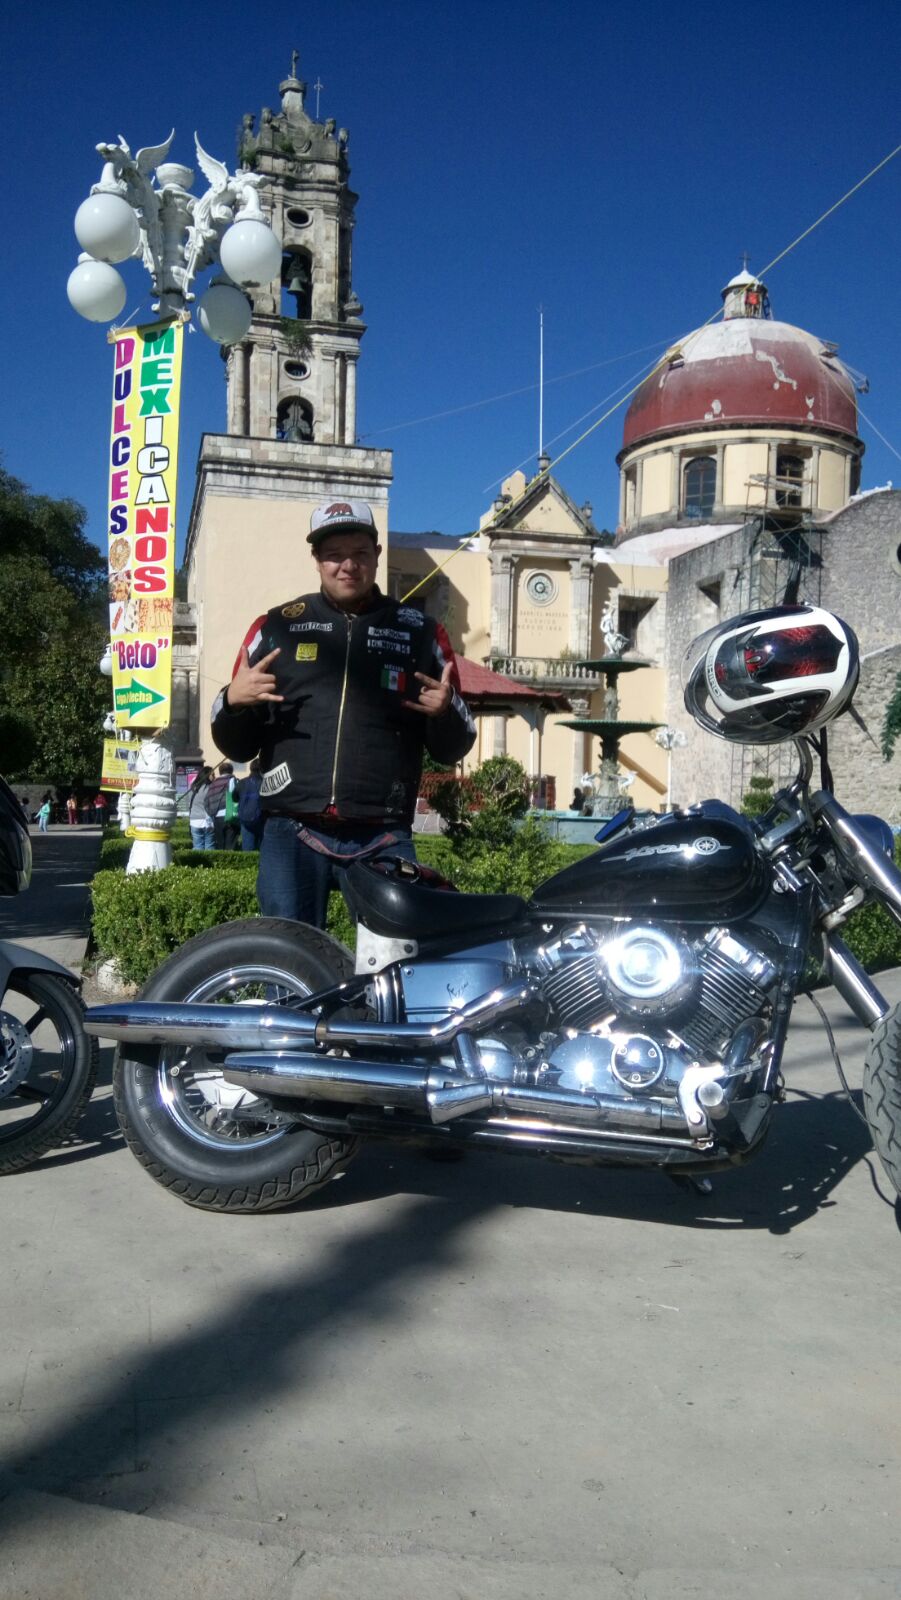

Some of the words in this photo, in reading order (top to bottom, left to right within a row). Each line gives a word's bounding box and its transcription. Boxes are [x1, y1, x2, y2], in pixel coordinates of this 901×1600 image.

[110, 337, 136, 535] DULCES
[134, 327, 175, 593] MEXICANOS
[112, 637, 169, 671] "Beto"
